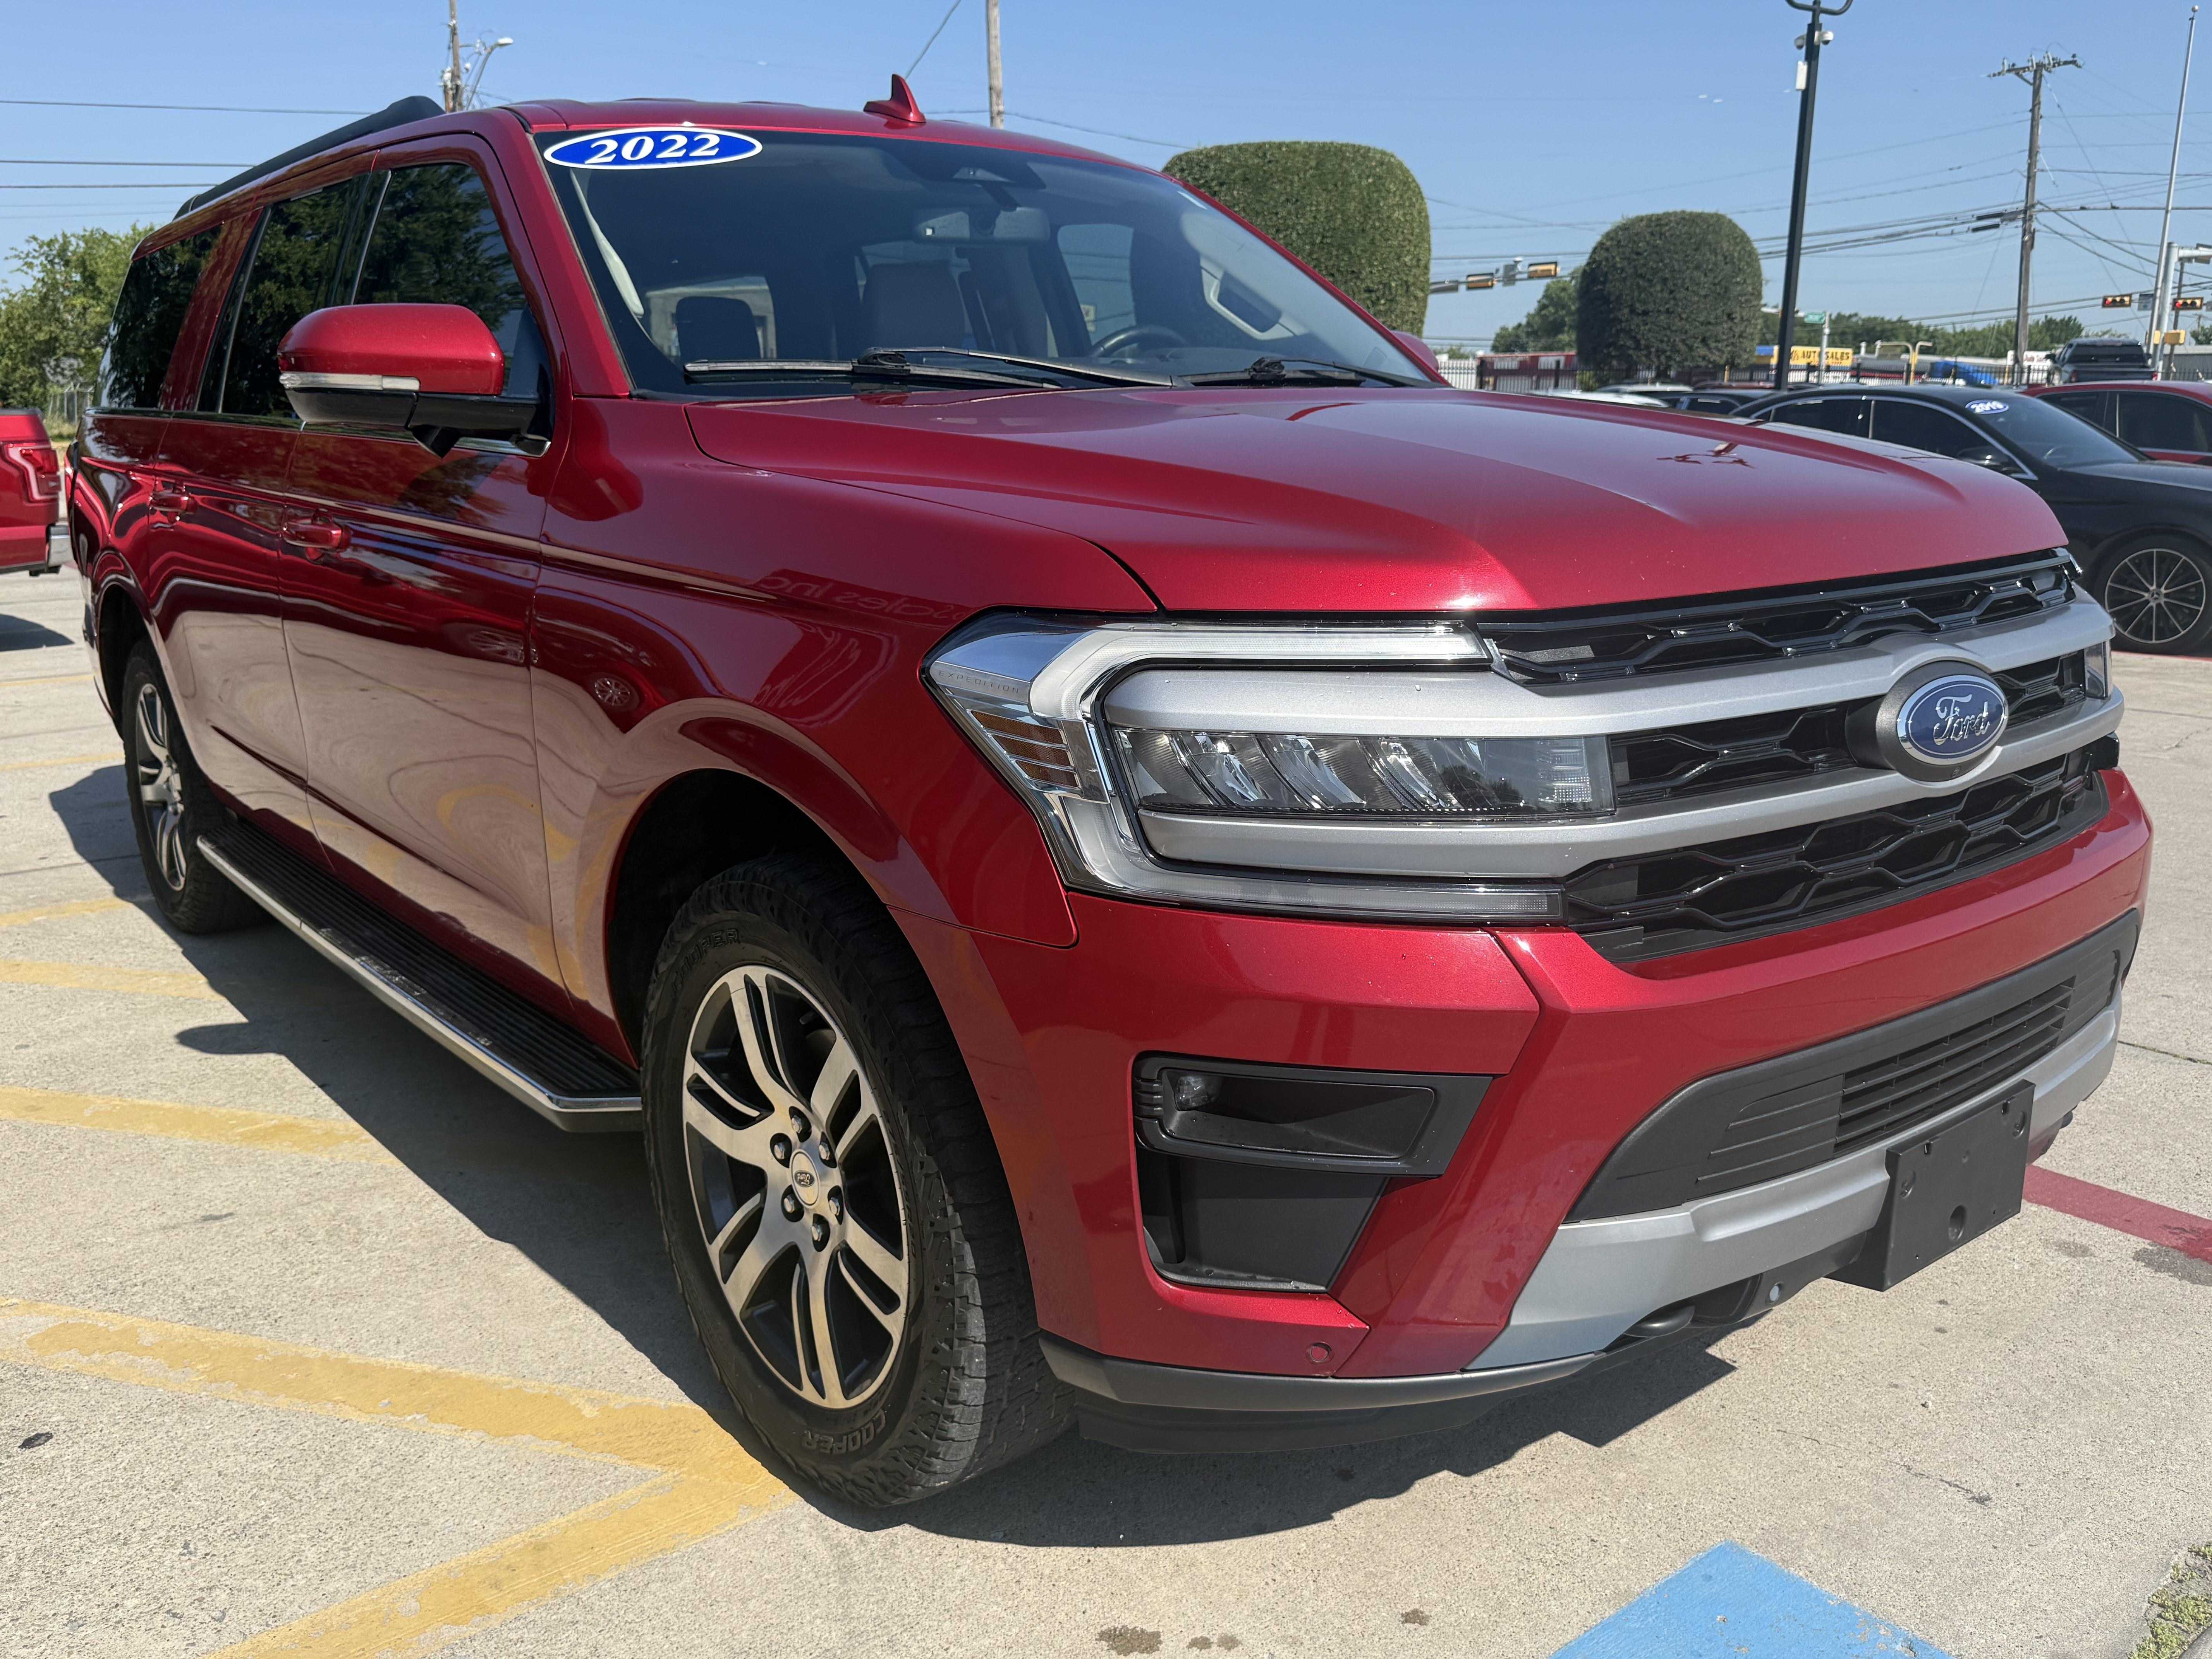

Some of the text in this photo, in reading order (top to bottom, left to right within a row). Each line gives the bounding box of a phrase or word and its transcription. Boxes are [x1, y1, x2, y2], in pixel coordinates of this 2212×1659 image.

[584, 134, 720, 164] 2022
[1801, 350, 1820, 359] AUT
[1825, 351, 1850, 361] SALES
[939, 670, 1019, 694] EXPEDITION
[1933, 694, 1990, 746] Ford
[672, 928, 741, 991] COOPER
[800, 1408, 887, 1455] COOPER
